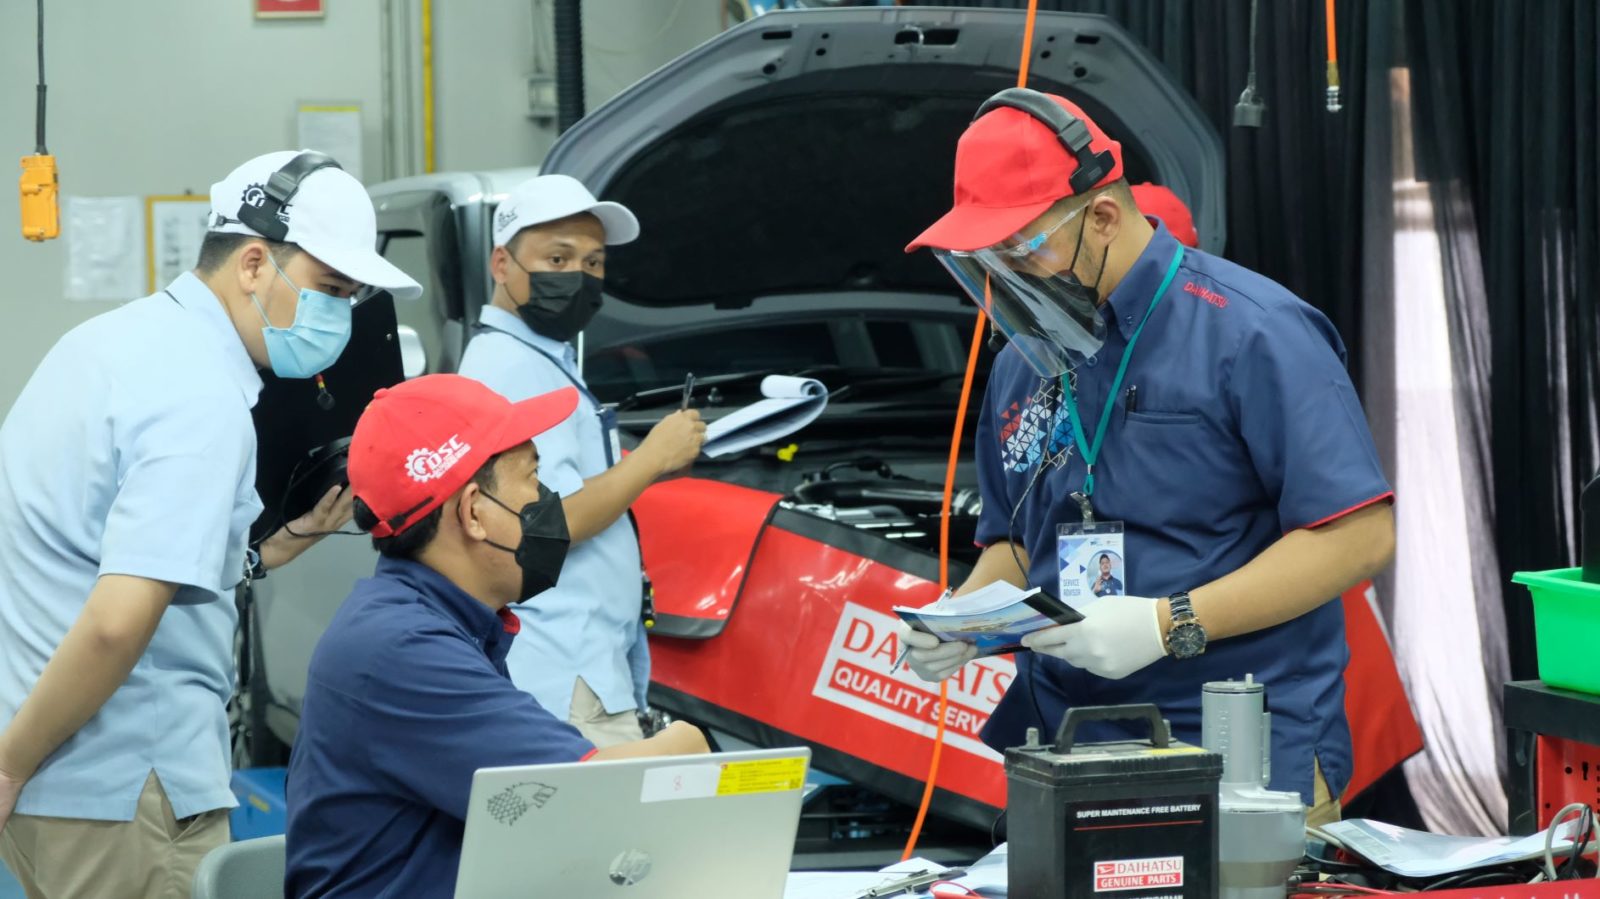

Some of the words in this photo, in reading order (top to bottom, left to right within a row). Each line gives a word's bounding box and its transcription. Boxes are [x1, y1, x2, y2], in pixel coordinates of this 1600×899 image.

[1184, 281, 1229, 308] DAIHATSU
[426, 433, 464, 471] DSC
[842, 617, 1012, 705] DAATS
[834, 667, 930, 714] QUALITY
[930, 701, 987, 735] SERV
[1076, 810, 1101, 819] SUPER
[1101, 806, 1150, 817] MAINTENANCE
[1151, 806, 1169, 814] FREE
[1170, 804, 1202, 813] BATTERY
[1117, 859, 1182, 874] DAIHATSU
[1100, 876, 1145, 889] GENUINE
[1147, 873, 1177, 885] PARTS
